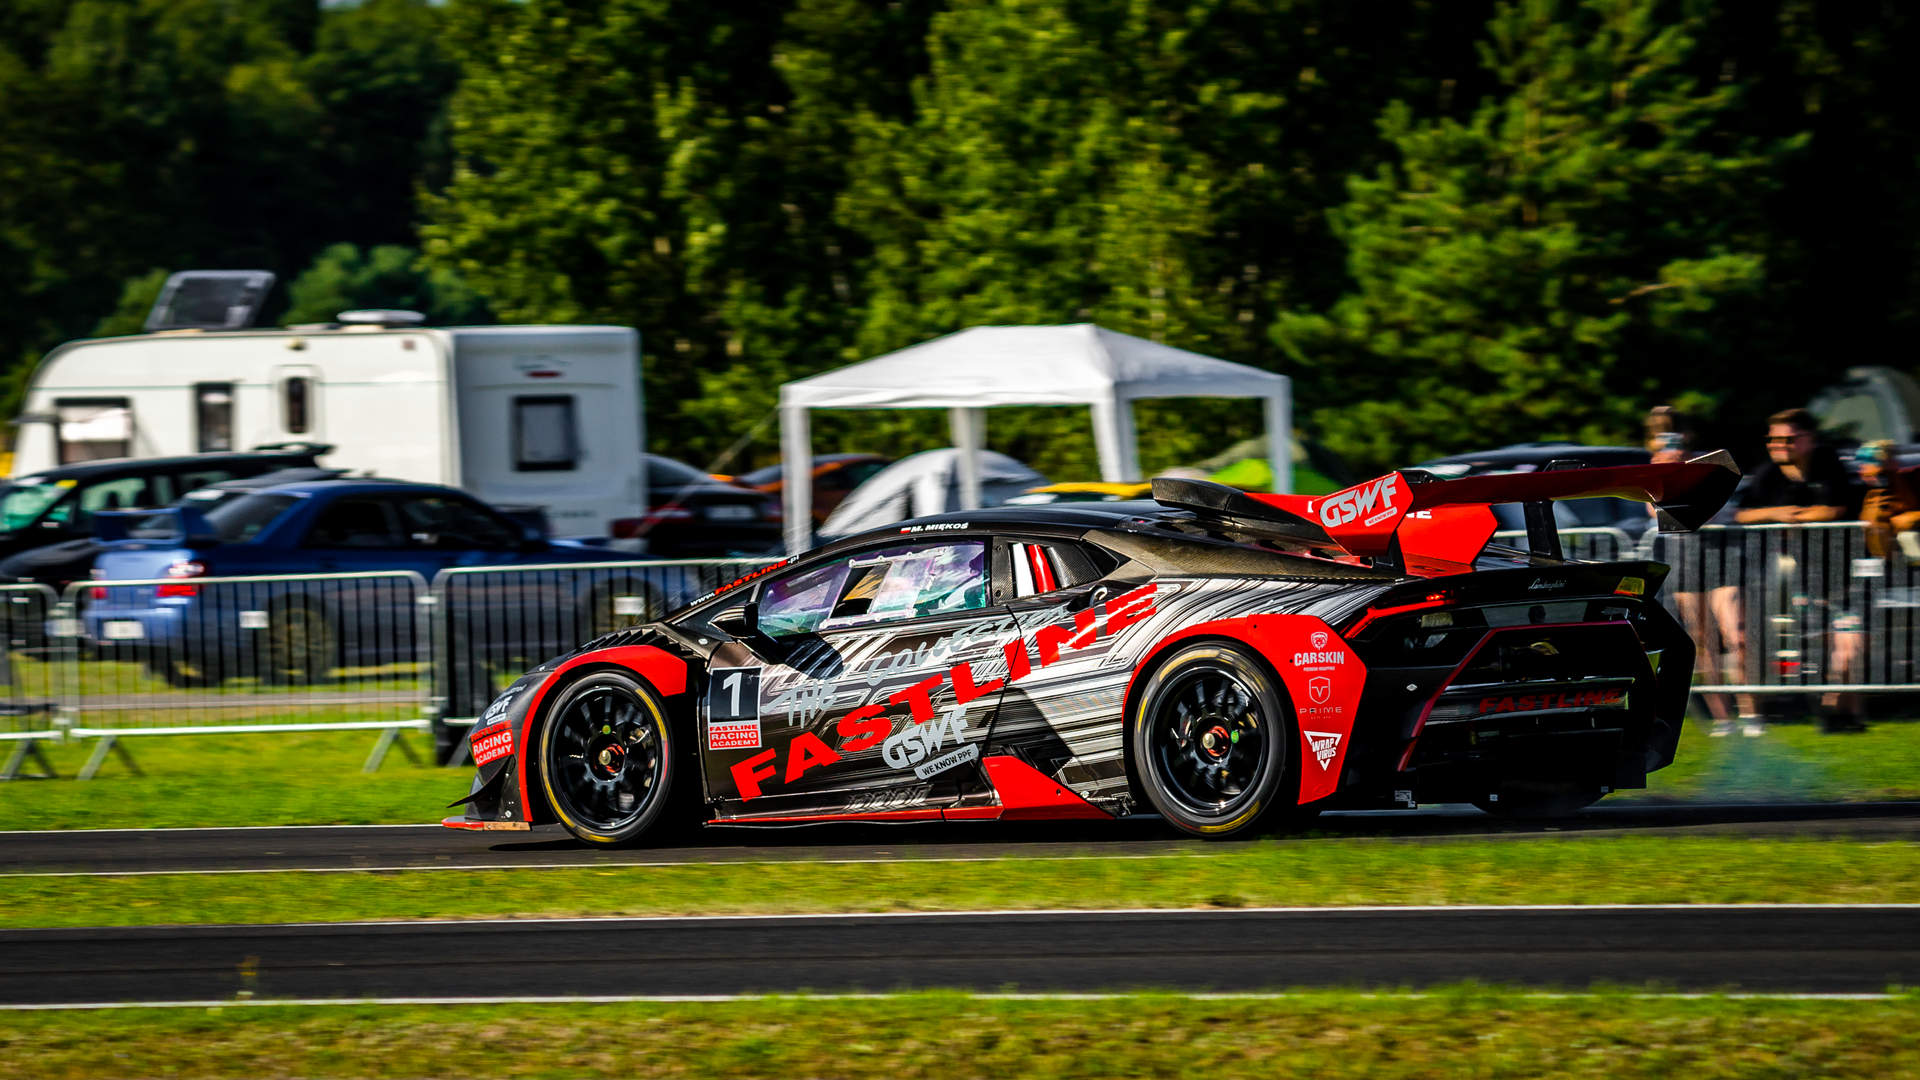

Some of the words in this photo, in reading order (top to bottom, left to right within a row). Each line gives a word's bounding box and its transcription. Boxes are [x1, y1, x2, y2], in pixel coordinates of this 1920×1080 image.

[1320, 474, 1398, 528] GSWF
[1294, 651, 1345, 667] CARSKIN
[722, 672, 743, 717] 1
[730, 583, 1158, 803] FASTLINE
[1479, 689, 1623, 713] FASTLINE
[1299, 706, 1343, 714] PRIME
[709, 724, 758, 732] FASTLINE
[711, 732, 757, 741] RACING
[882, 704, 969, 769] GSWF
[473, 732, 512, 756] RACING
[712, 739, 757, 747] ACADEMY
[1311, 738, 1335, 753] WRAP
[921, 765, 936, 776] WE
[936, 755, 957, 770] KNOW
[957, 749, 972, 761] PPF
